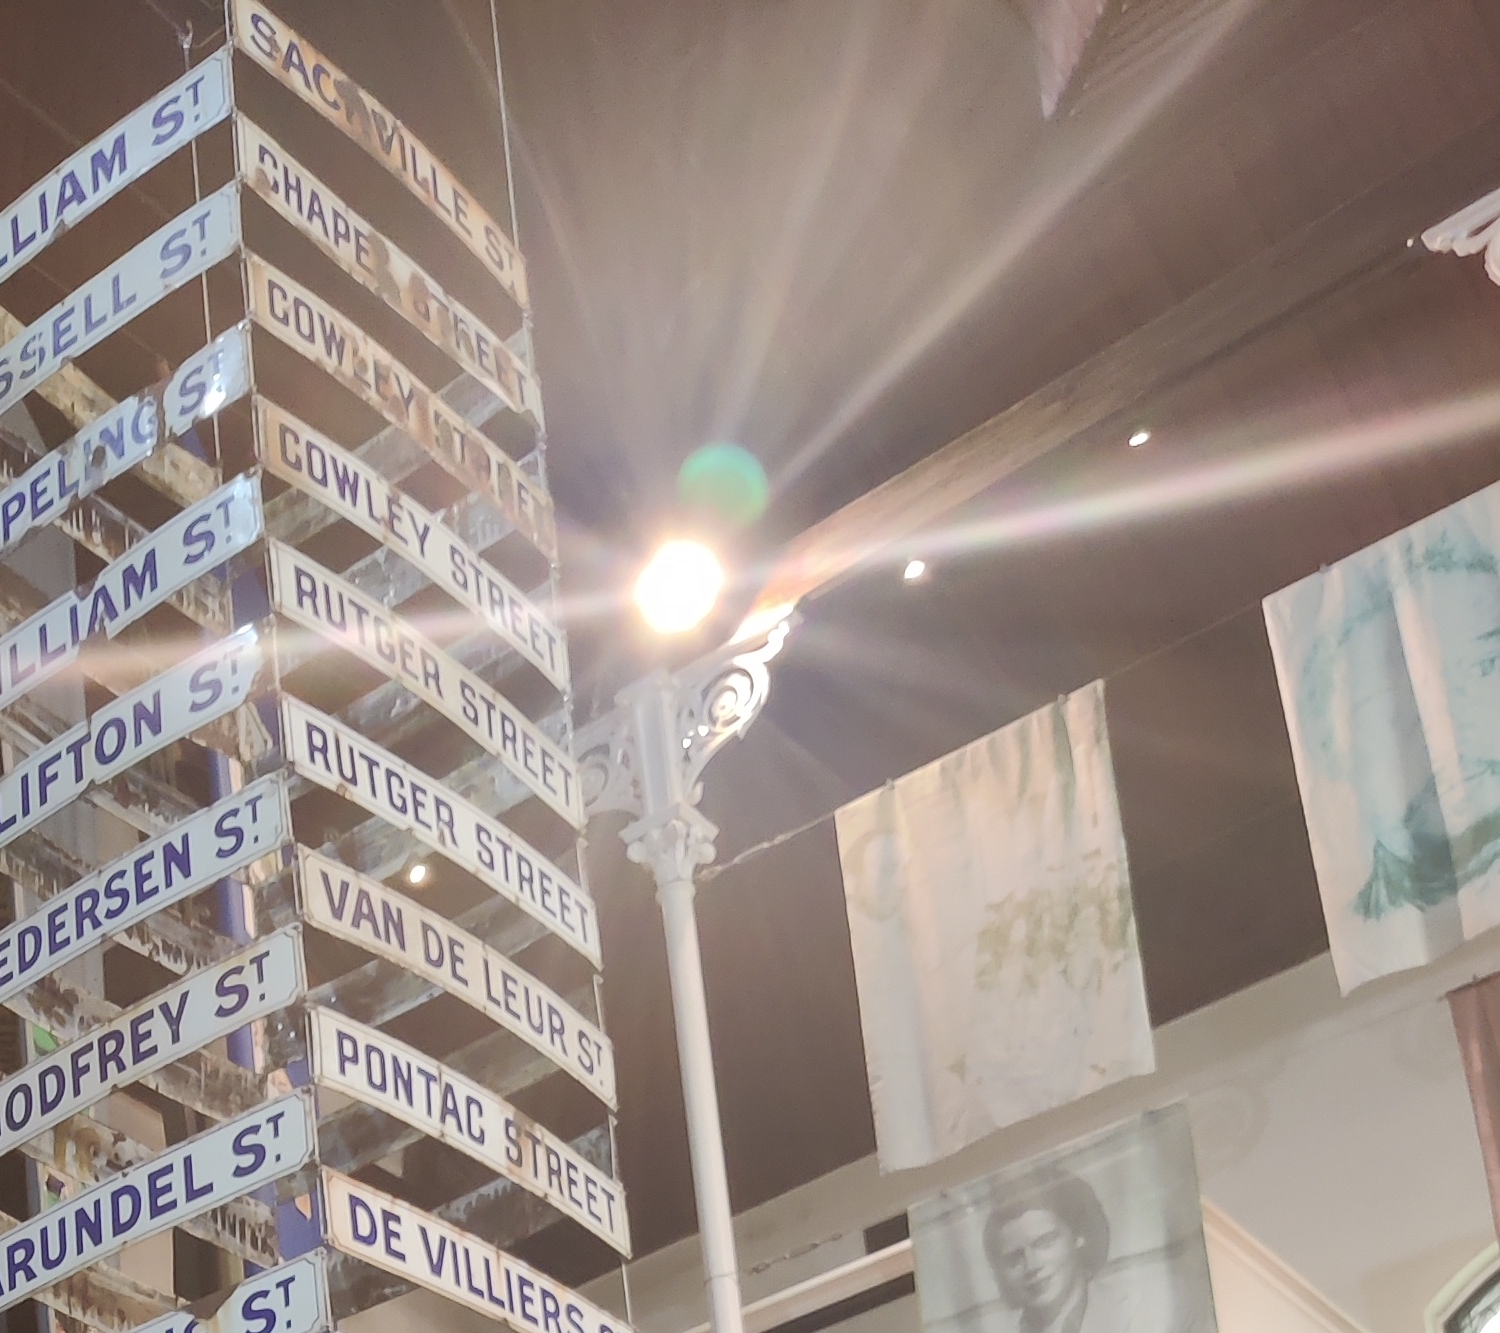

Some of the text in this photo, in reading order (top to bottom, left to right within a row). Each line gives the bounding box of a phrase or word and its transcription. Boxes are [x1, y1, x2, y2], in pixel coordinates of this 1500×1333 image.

[250, 12, 473, 239] SACVILLE
[258, 143, 390, 290] CHAPE
[279, 423, 430, 557] COWLEY
[449, 544, 558, 674] STREET
[294, 565, 574, 808] RUTGER STREET
[305, 720, 589, 944] RUTGER STREET
[320, 869, 407, 952] VAN
[420, 919, 469, 987] DE
[483, 957, 568, 1057] LEUR
[336, 1029, 615, 1234] PONTAC STREET
[348, 1192, 406, 1262] DE
